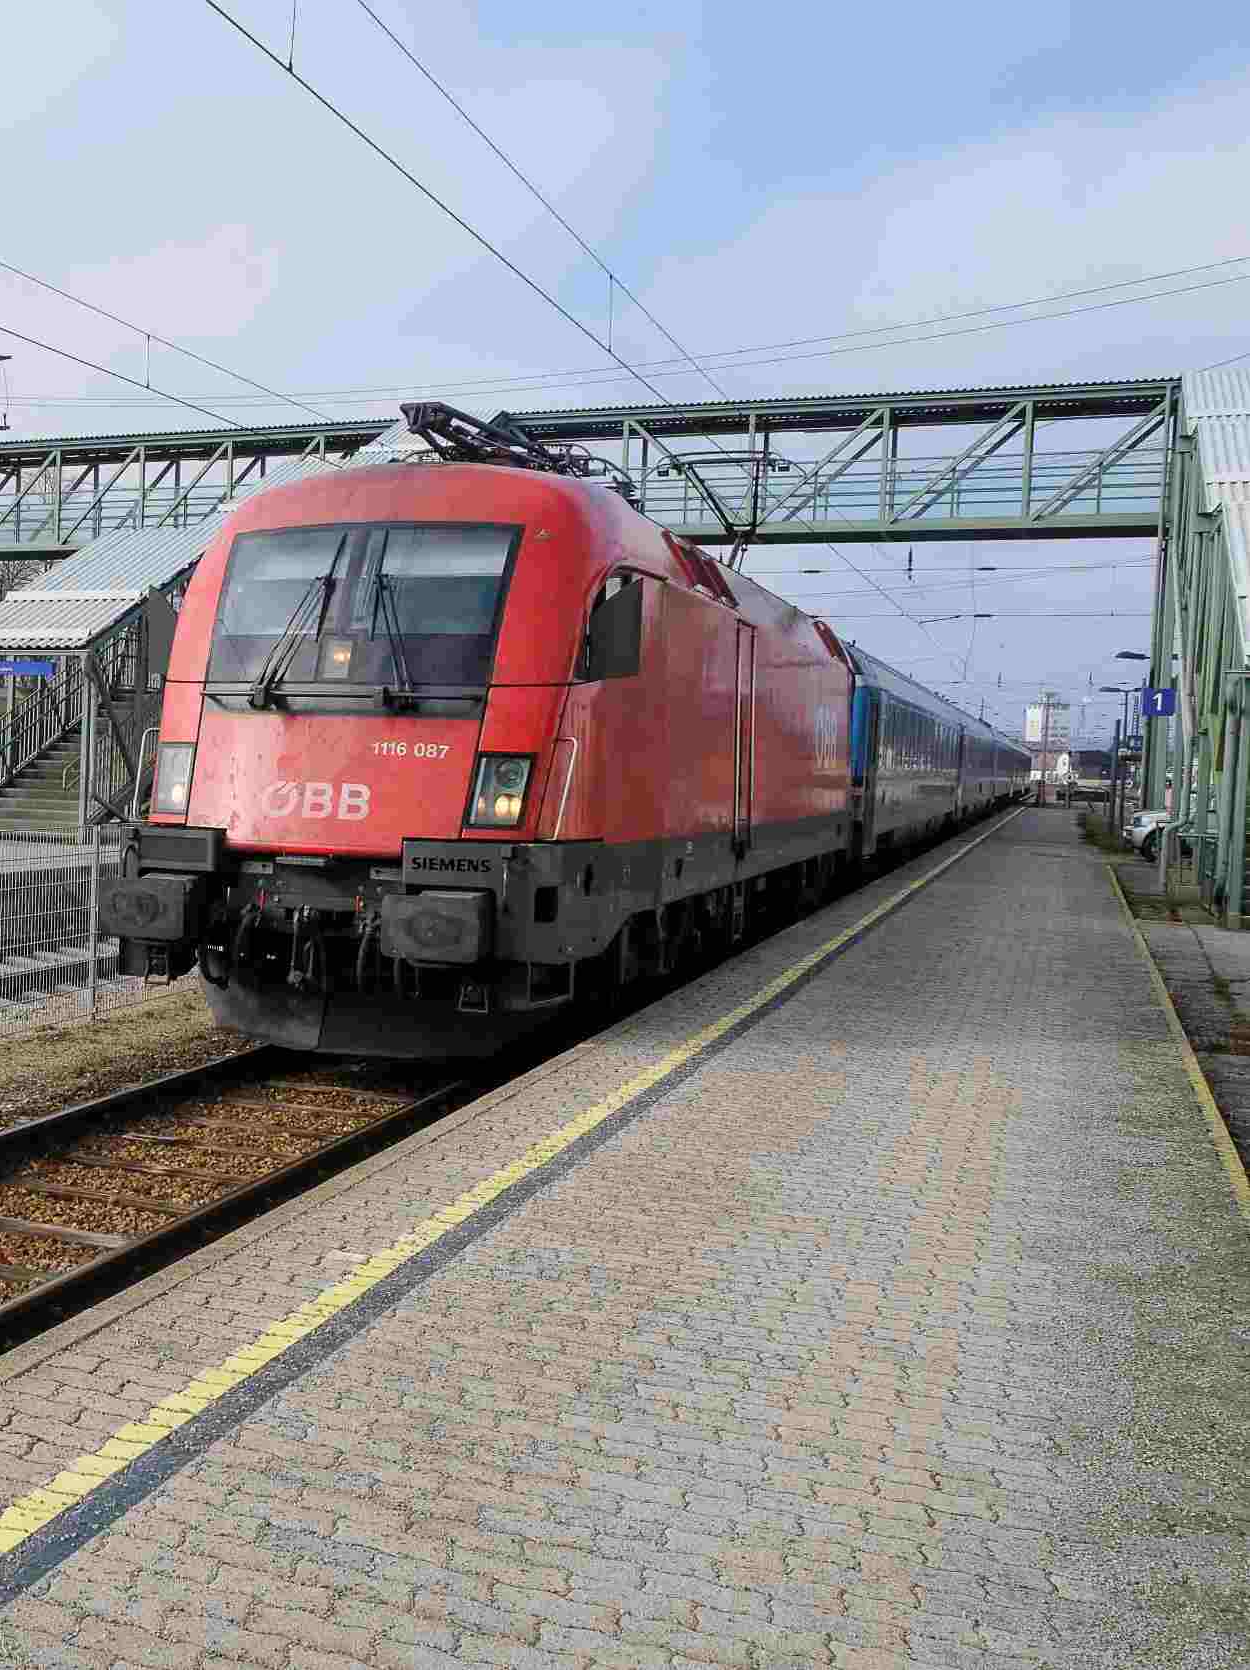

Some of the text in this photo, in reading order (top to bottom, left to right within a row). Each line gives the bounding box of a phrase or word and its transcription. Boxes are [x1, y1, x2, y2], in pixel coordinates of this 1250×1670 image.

[1152, 692, 1163, 711] 1
[371, 741, 450, 759] 1116 087
[262, 777, 371, 821] ÖBB
[411, 856, 493, 873] SIEMENS
